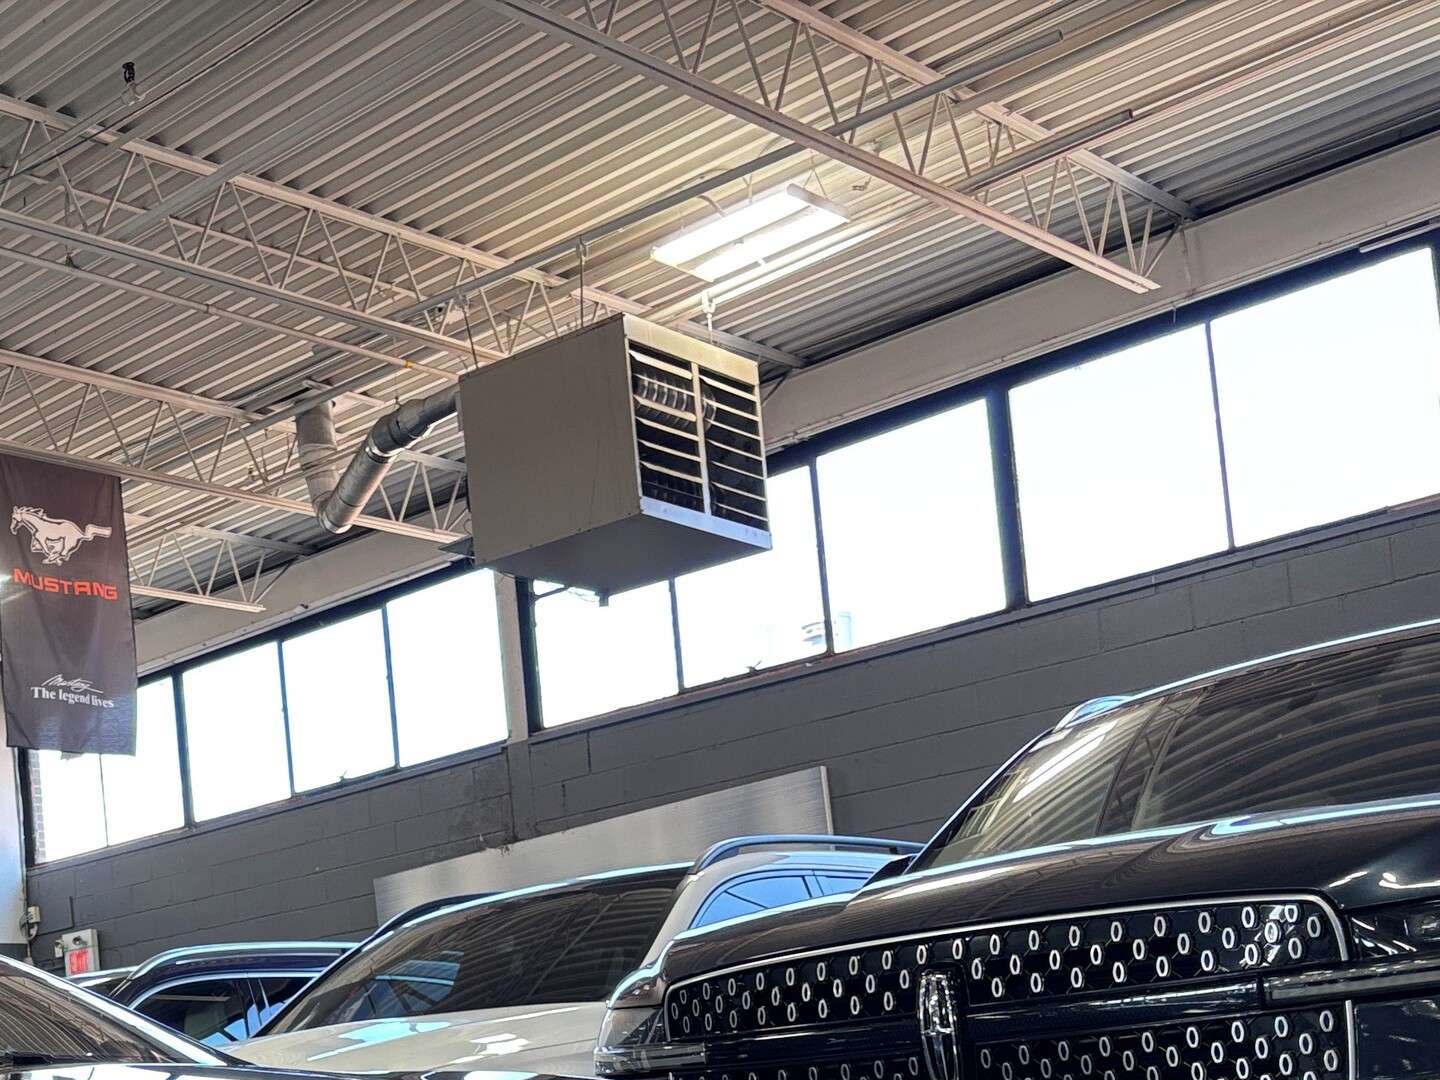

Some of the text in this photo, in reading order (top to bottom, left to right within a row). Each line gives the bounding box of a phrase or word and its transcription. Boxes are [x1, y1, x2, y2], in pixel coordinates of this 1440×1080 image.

[13, 568, 119, 601] MUSTANG
[30, 686, 115, 709] The legend lives
